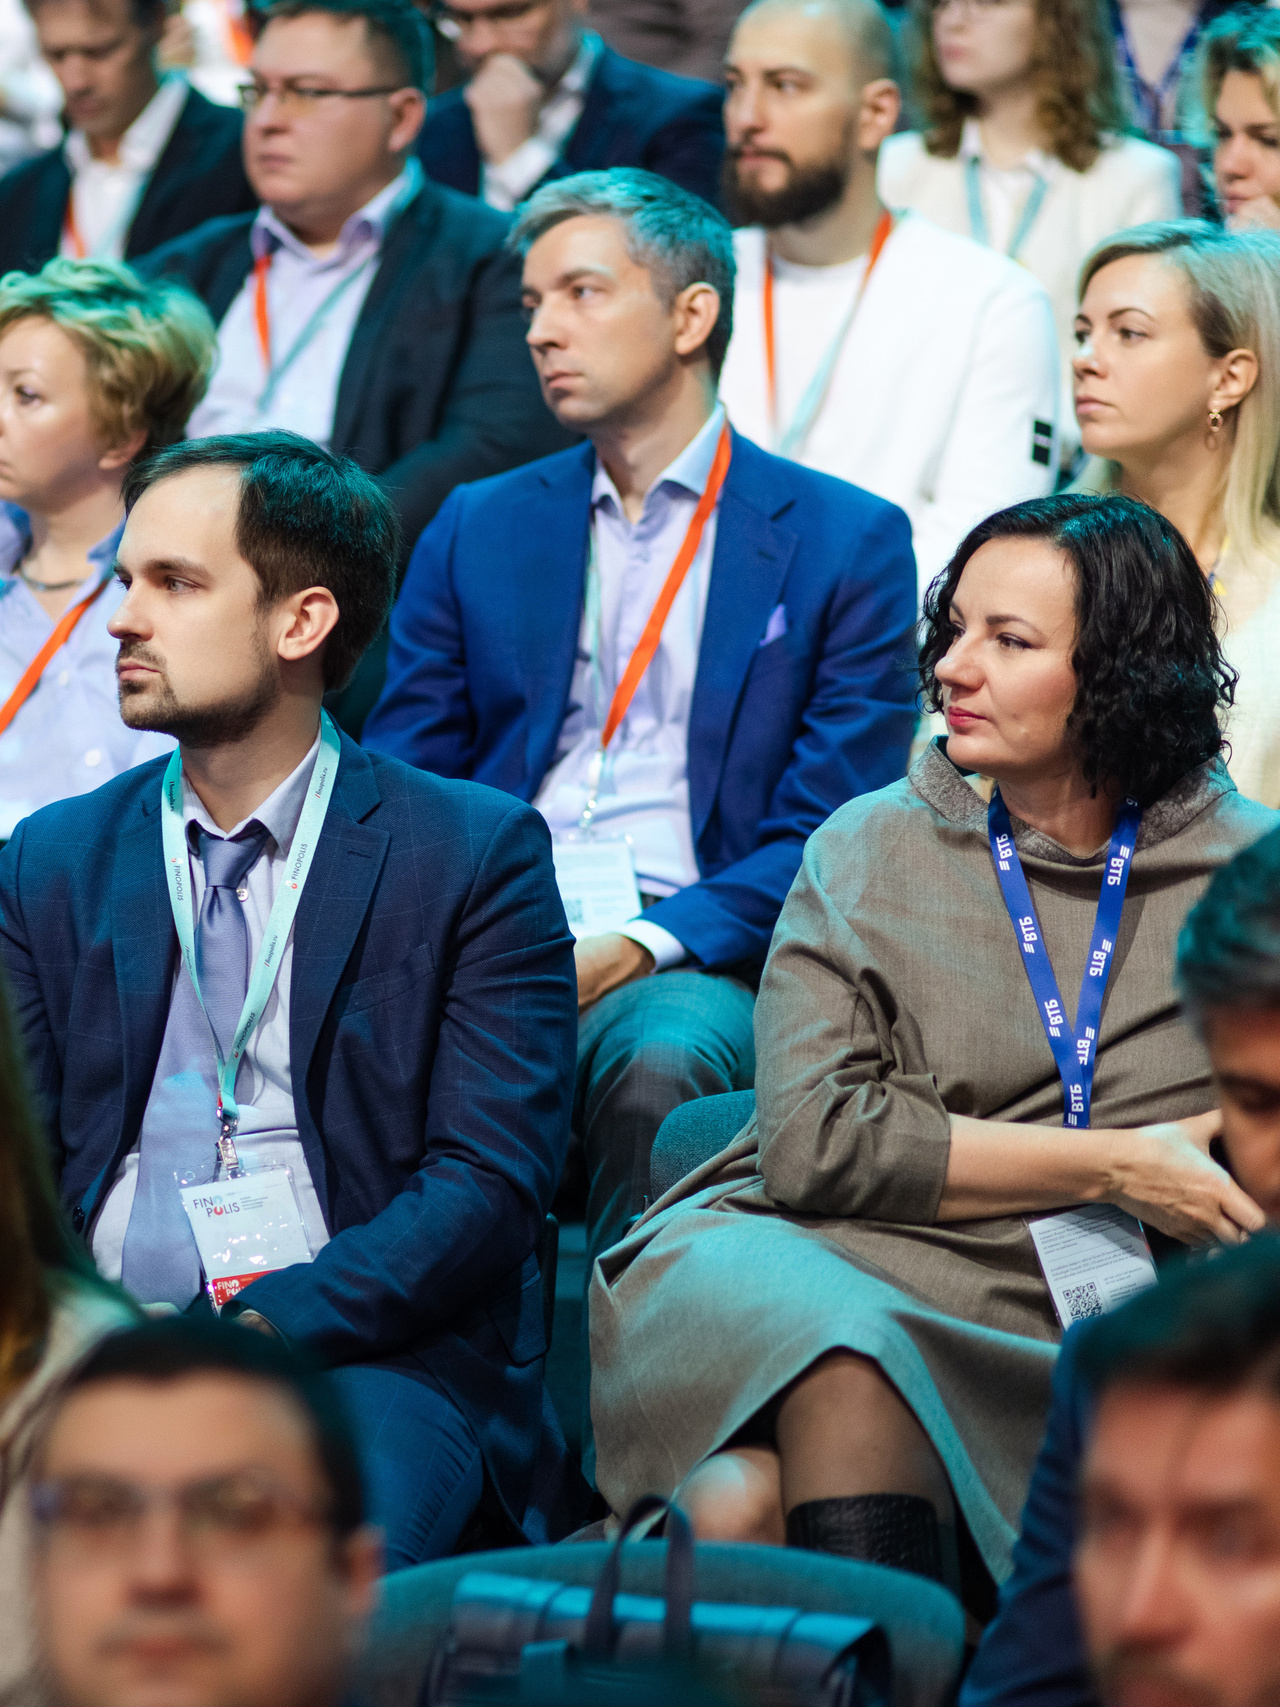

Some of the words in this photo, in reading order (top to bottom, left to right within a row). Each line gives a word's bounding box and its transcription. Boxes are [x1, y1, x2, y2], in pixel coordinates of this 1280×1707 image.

[996, 833, 1013, 860] ВТБ
[291, 843, 308, 880] FINOPOLIS
[1107, 857, 1125, 886] ВТБ
[174, 865, 184, 901] FINOPOLIS
[1019, 916, 1038, 942] ВТБ
[1089, 950, 1107, 977] ВТБ
[1044, 999, 1064, 1026] ВТБ
[237, 1012, 256, 1049] FINOPOLIS
[1070, 1083, 1084, 1112] ВТБ
